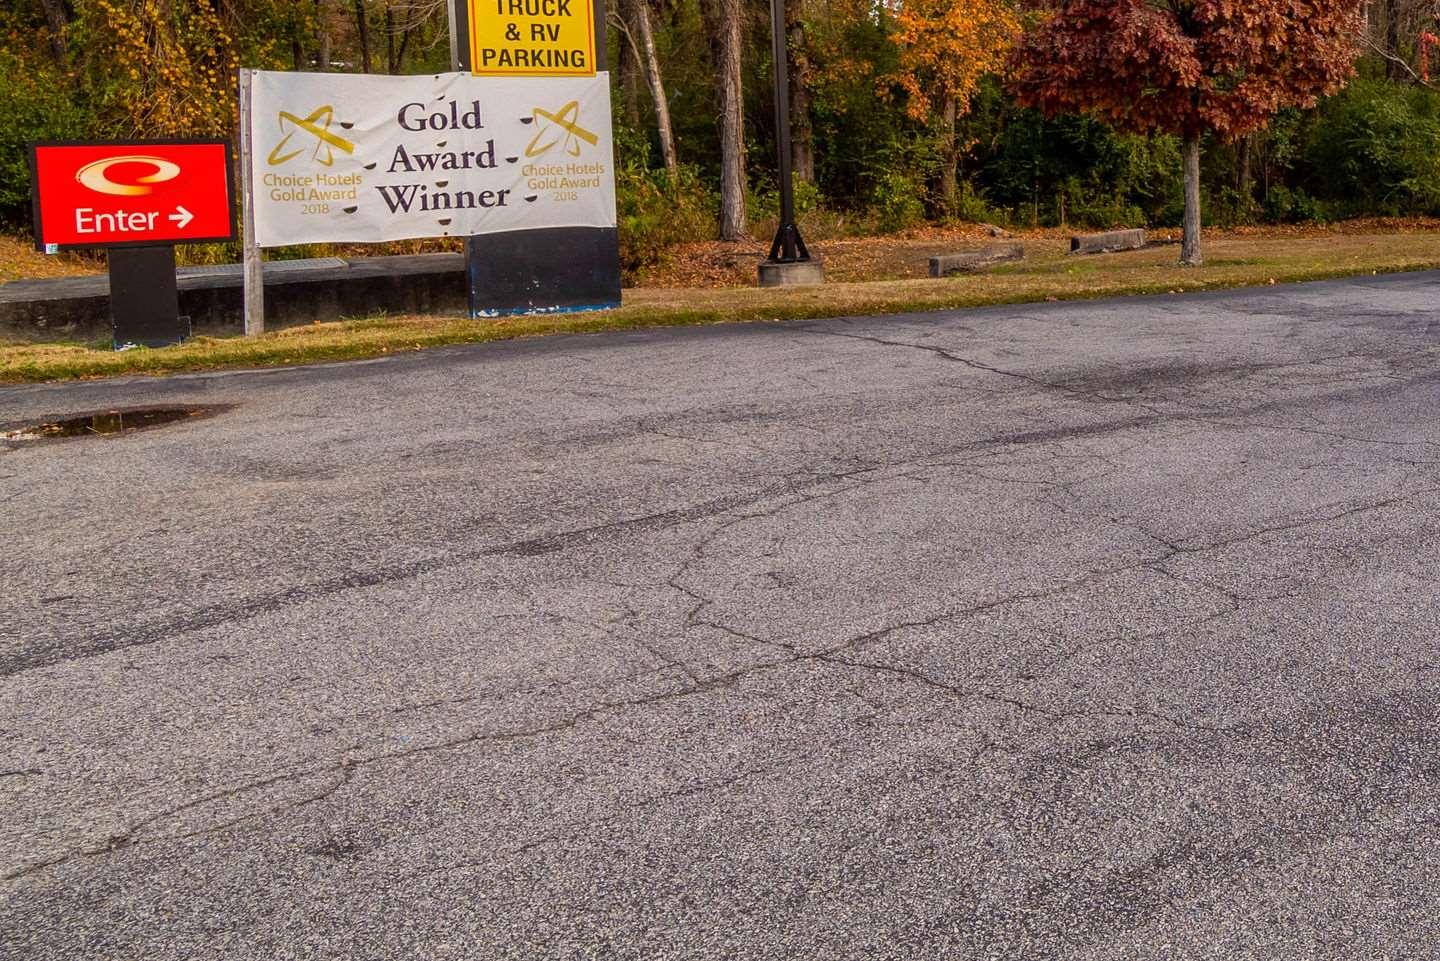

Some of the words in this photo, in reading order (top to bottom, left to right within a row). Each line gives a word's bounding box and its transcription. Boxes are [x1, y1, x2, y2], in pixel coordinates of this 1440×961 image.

[504, 24, 521, 42] &
[530, 24, 561, 42] RV
[482, 48, 585, 68] PARKING
[397, 100, 484, 132] Gold
[386, 140, 498, 173] Award
[522, 164, 563, 176] Choice
[566, 162, 605, 175] Hotels
[263, 173, 312, 186] Choice
[316, 172, 363, 186] Hotels
[527, 177, 557, 189] Gold
[559, 176, 600, 188] Award
[270, 188, 305, 201] Gold
[309, 186, 357, 201] Award
[375, 184, 511, 214] Winner
[553, 191, 578, 201] 2018
[302, 204, 330, 214] 2018
[75, 207, 159, 233] Enter
